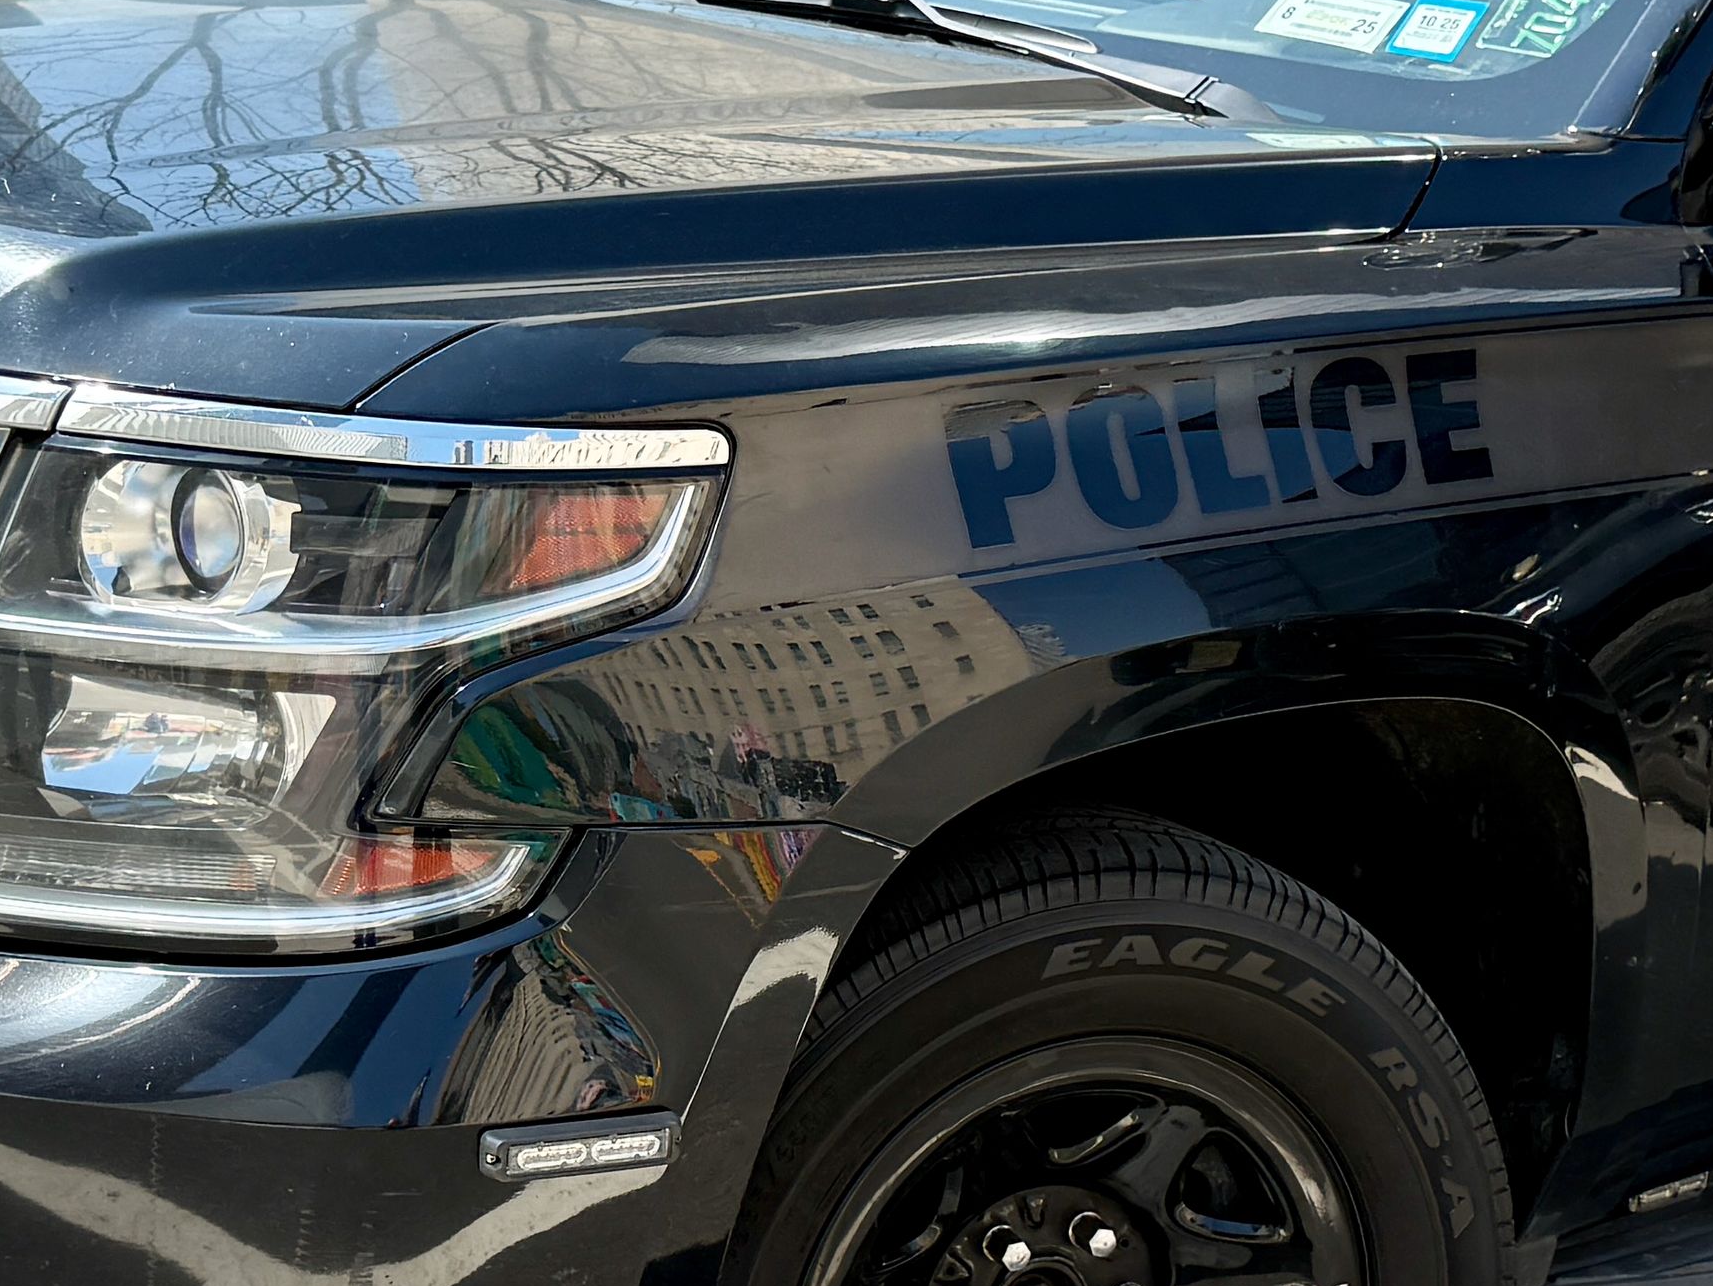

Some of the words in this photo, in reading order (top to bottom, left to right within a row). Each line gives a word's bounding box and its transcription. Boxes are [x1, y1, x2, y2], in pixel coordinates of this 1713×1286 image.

[1281, 6, 1296, 20] 8
[1350, 18, 1379, 35] 25
[1420, 15, 1438, 28] 10
[1440, 17, 1461, 31] 25
[944, 349, 1494, 549] POLICE
[1040, 935, 1349, 1017] EAGLE
